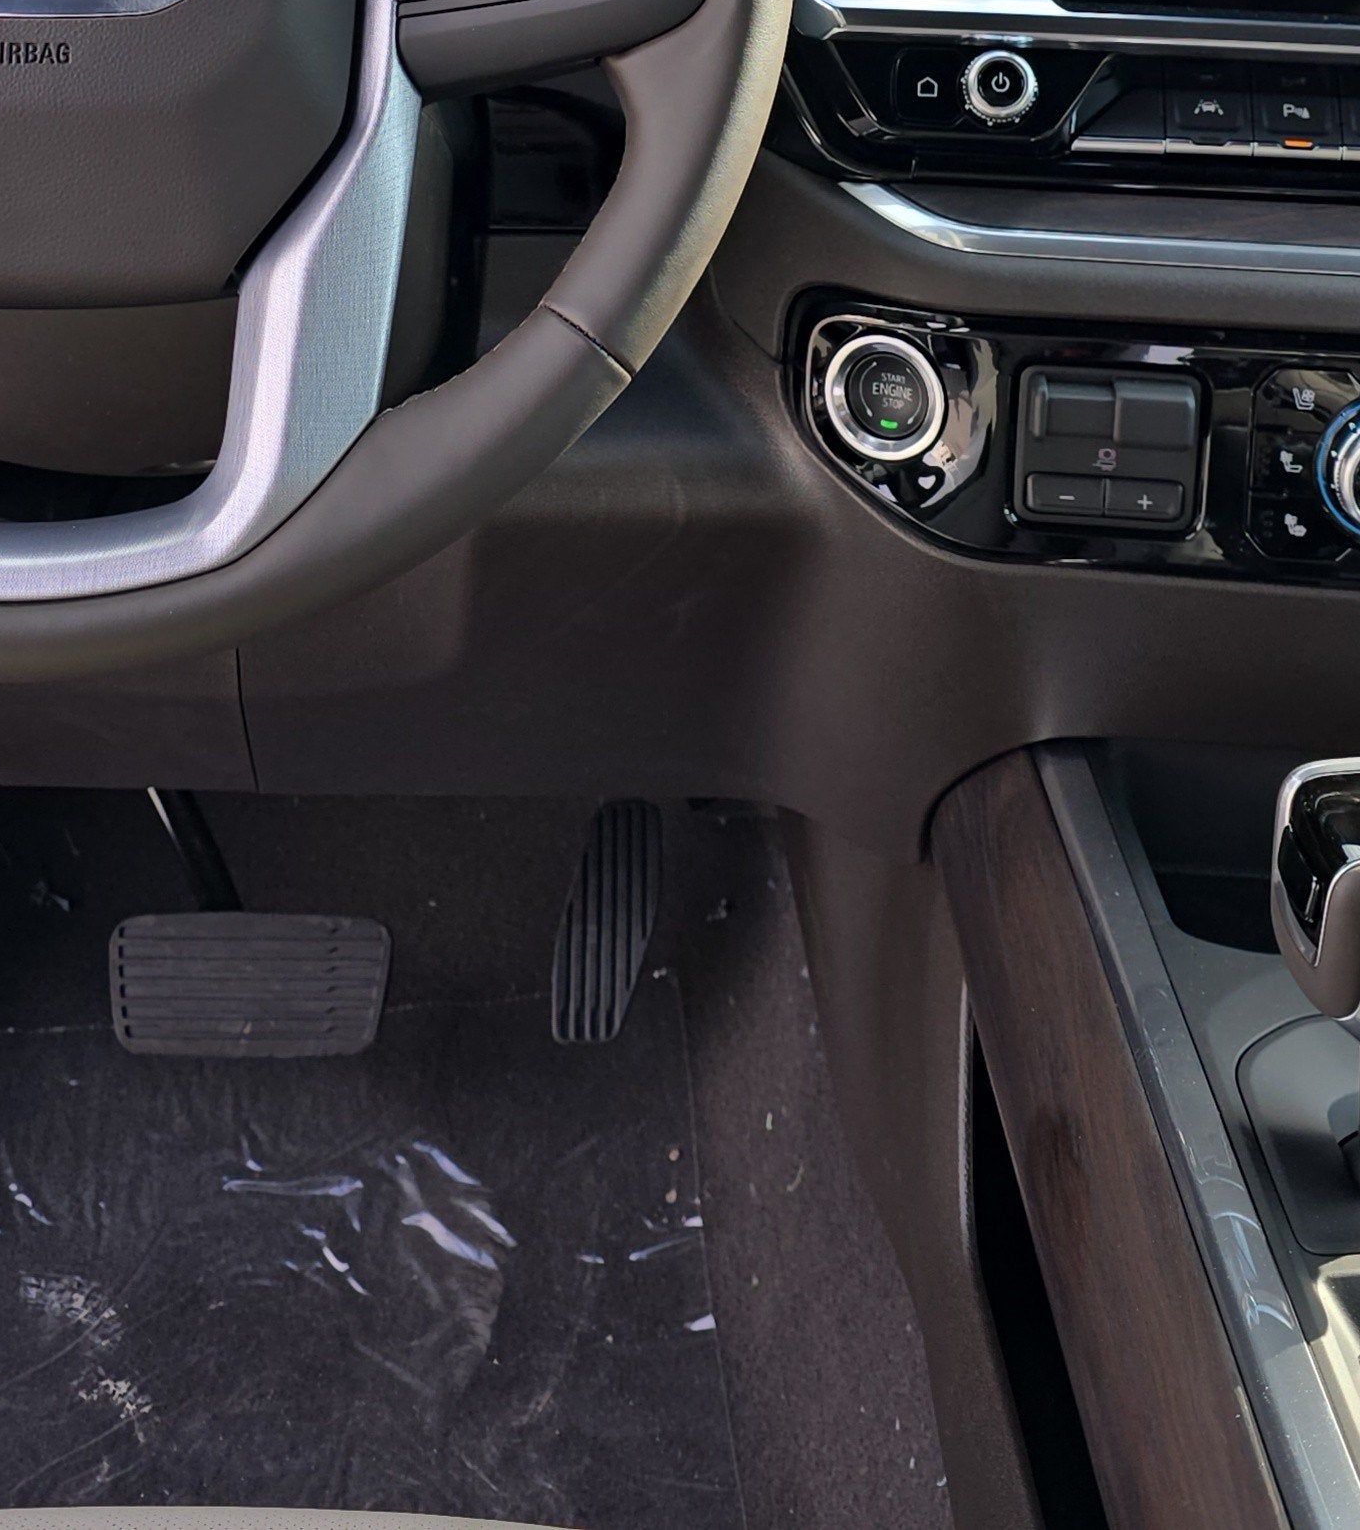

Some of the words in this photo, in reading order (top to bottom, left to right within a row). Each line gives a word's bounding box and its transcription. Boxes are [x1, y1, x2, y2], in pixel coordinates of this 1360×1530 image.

[881, 372, 906, 384] START
[872, 382, 913, 401] ENGINE
[881, 397, 904, 410] STOP
